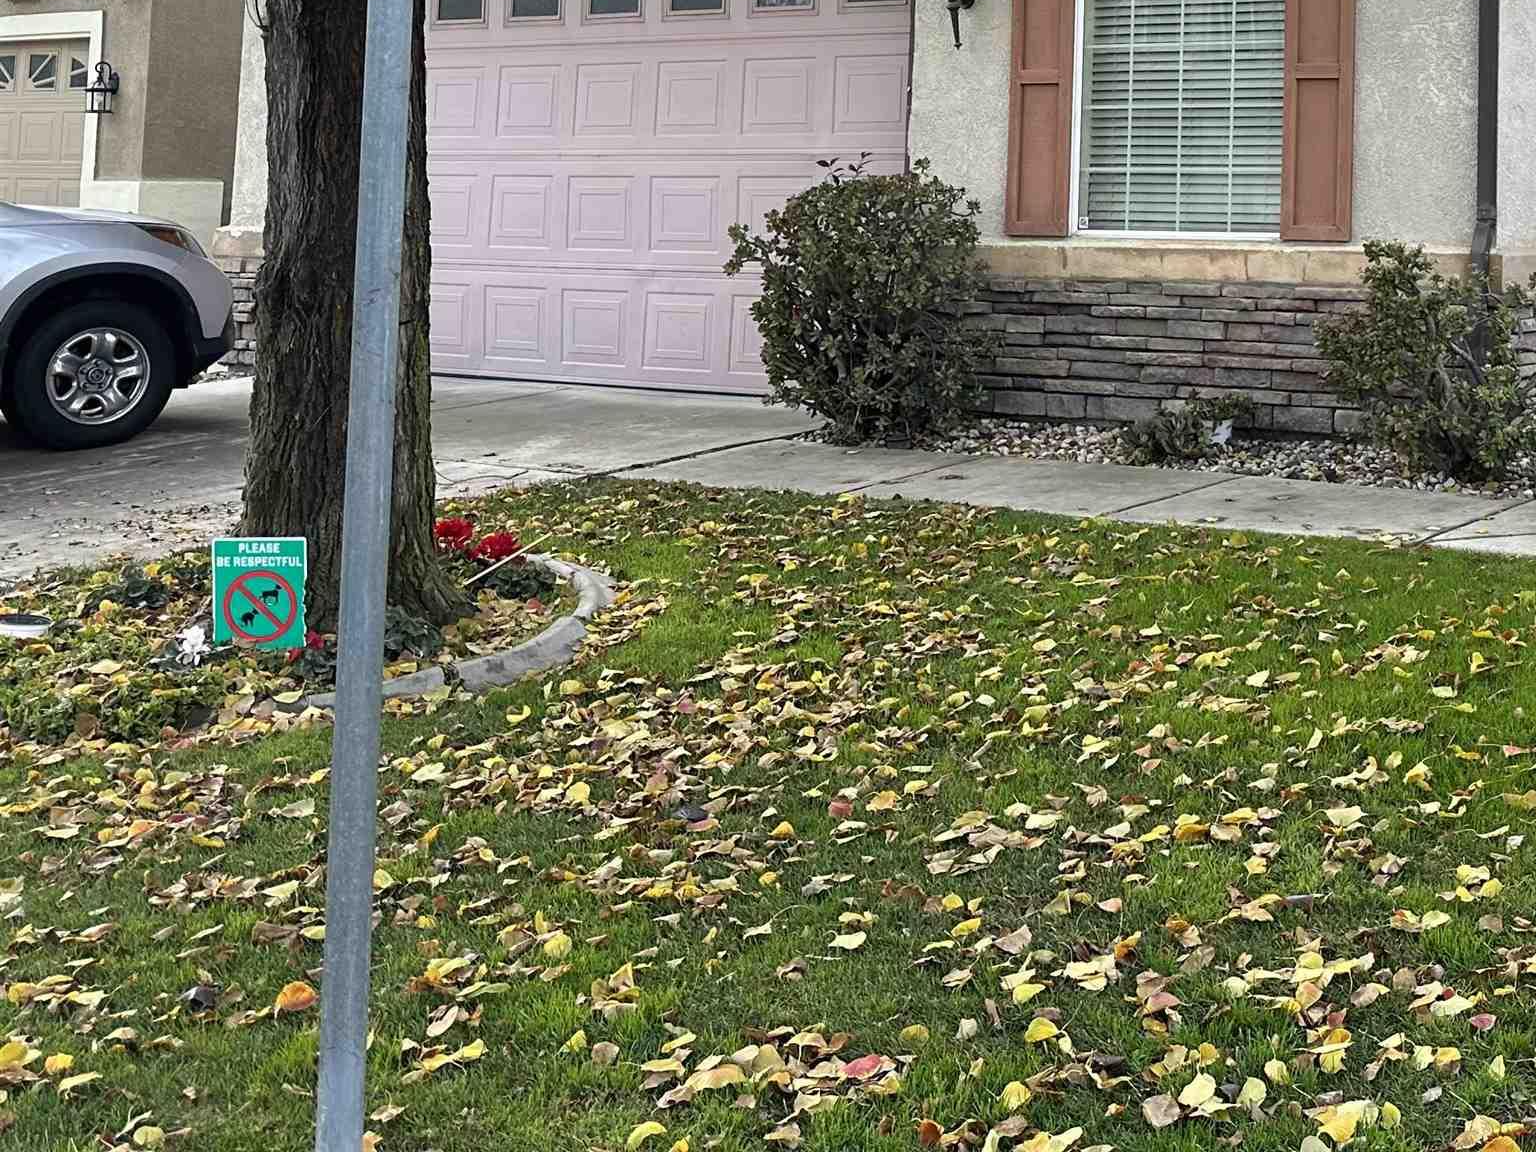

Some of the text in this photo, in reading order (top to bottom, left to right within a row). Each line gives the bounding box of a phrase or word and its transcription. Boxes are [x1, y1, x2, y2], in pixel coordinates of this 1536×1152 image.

[238, 542, 281, 554] PLEASE
[216, 556, 302, 567] BE RESPECTFUL
